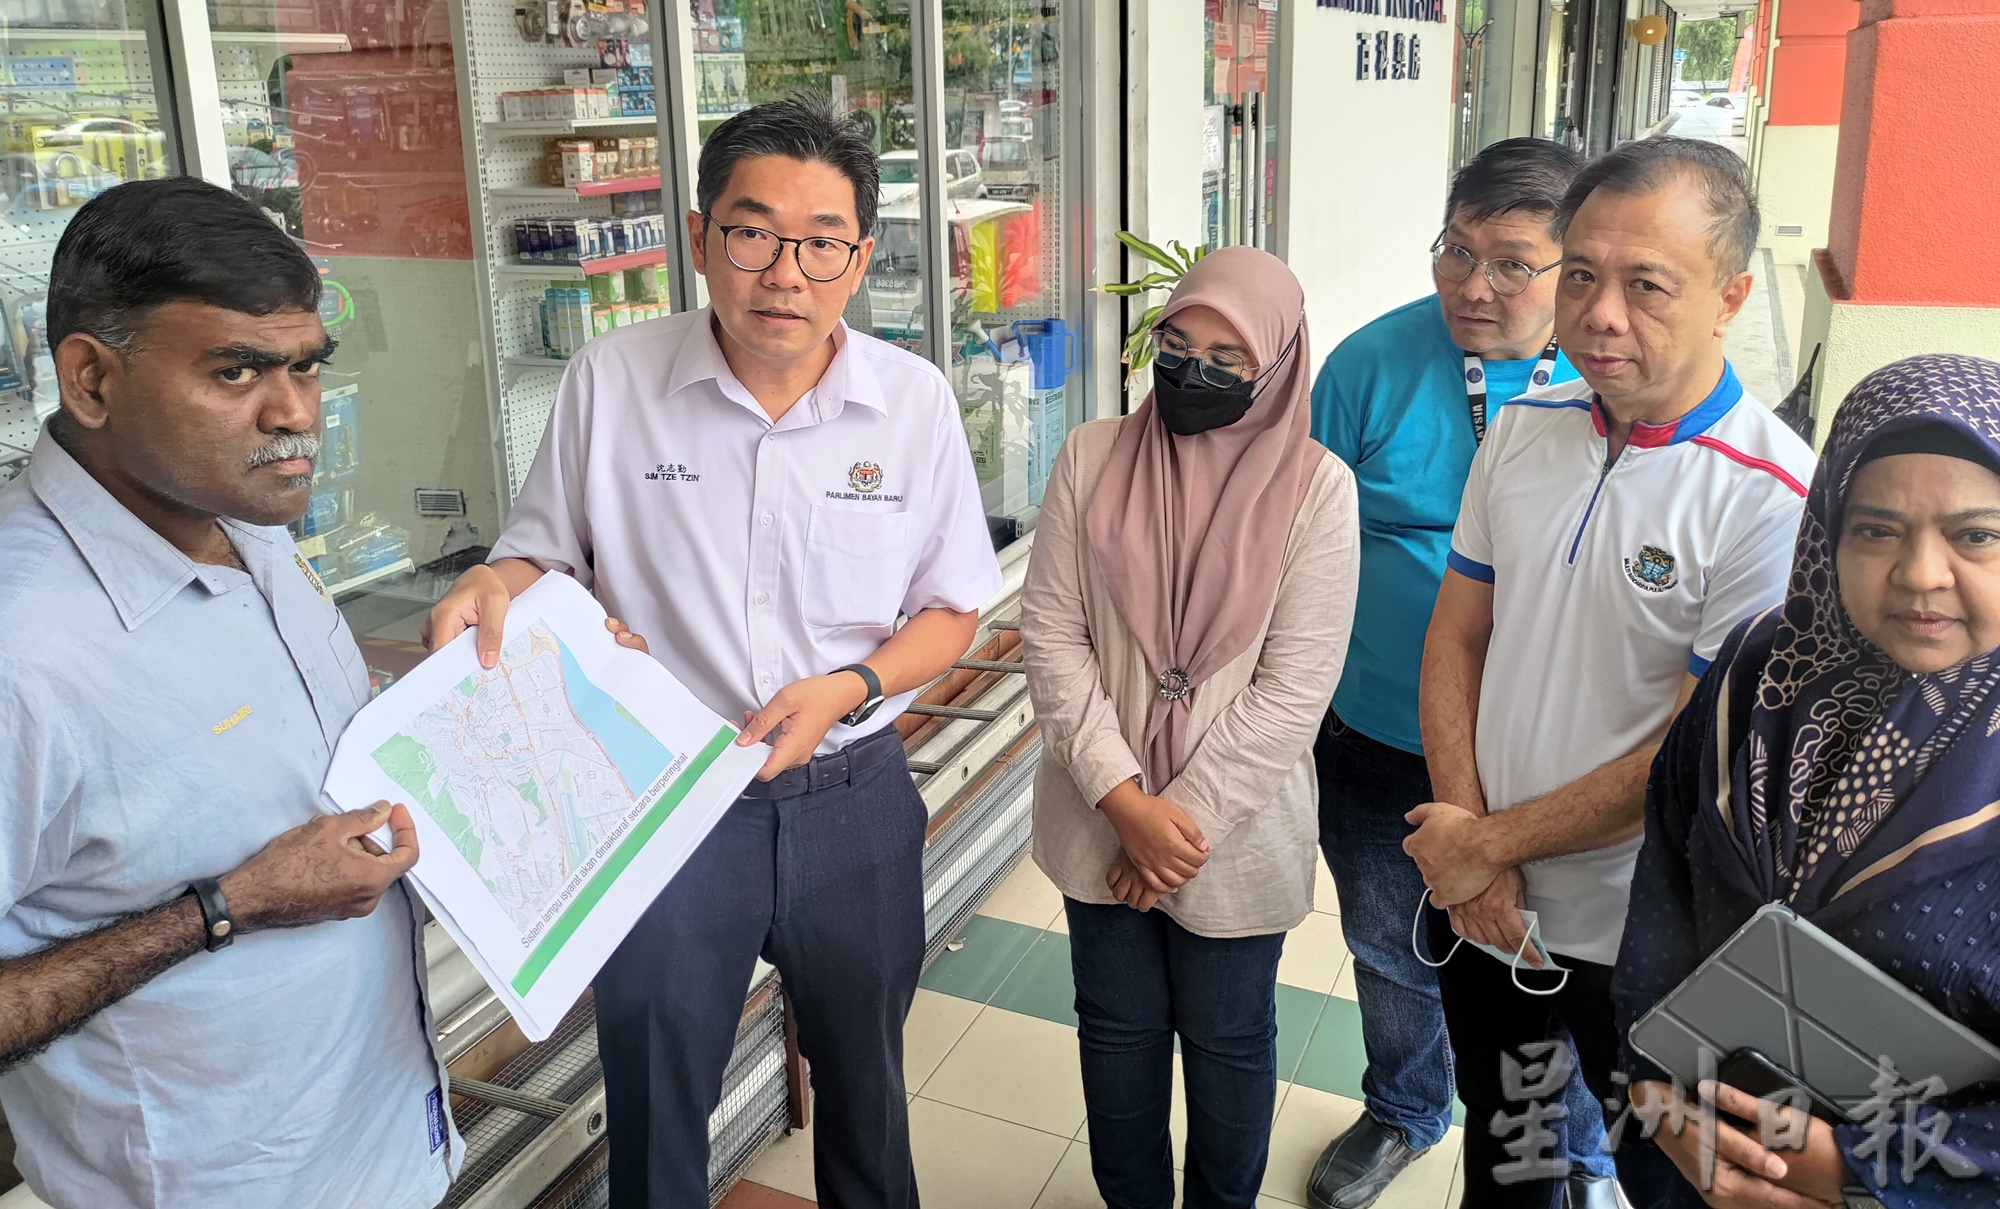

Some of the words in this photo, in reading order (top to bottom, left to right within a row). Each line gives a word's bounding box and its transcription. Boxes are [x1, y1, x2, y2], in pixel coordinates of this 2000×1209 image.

[656, 464, 687, 473] 沈志勤
[826, 491, 860, 500] PARLIMEN
[521, 920, 545, 949] Sistem
[541, 898, 563, 923] lampu
[561, 874, 583, 902] isyarat
[579, 857, 598, 878] akan
[595, 817, 630, 860] dinaiktaraf
[628, 794, 652, 822] secara
[649, 752, 689, 798] berperingkat
